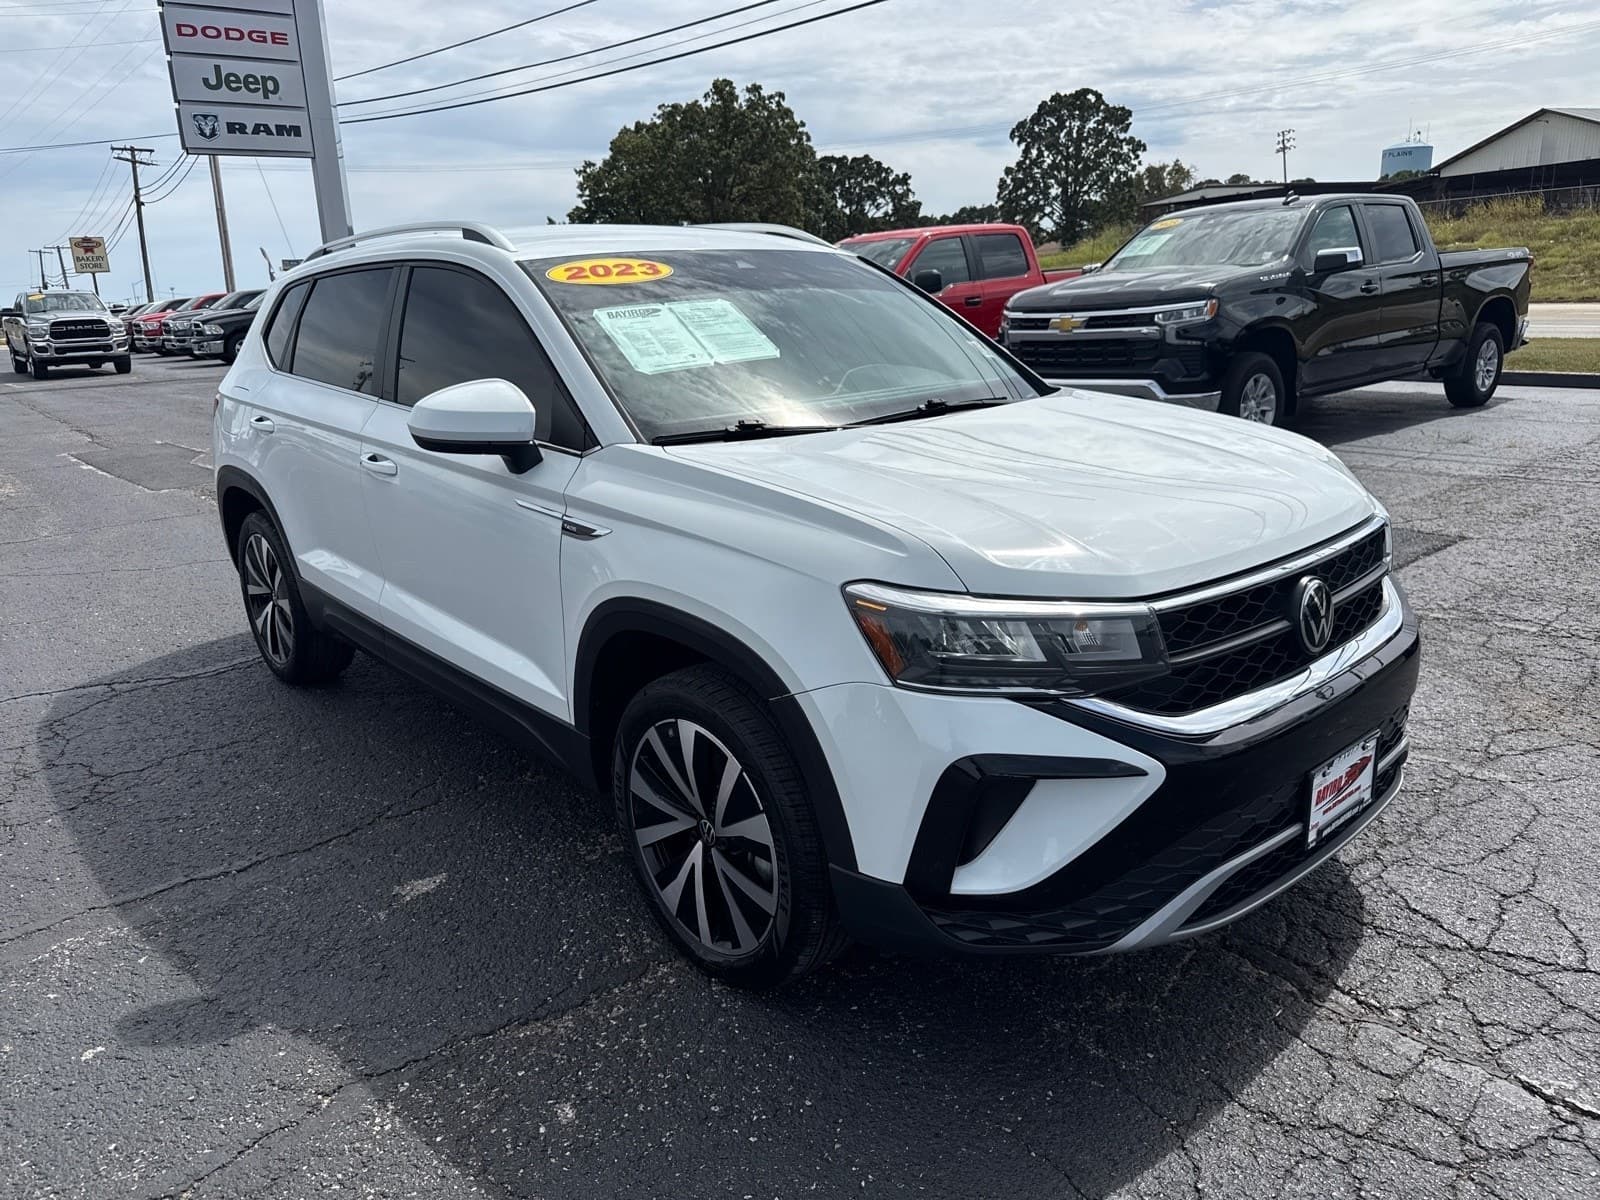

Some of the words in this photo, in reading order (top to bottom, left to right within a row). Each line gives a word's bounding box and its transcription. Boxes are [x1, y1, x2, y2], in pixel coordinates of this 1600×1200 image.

[176, 23, 289, 45] DODGE
[201, 64, 280, 100] Jeep
[226, 121, 302, 138] RAM
[76, 255, 105, 263] BAKERY
[79, 262, 105, 270] STORE
[563, 262, 662, 280] 2023
